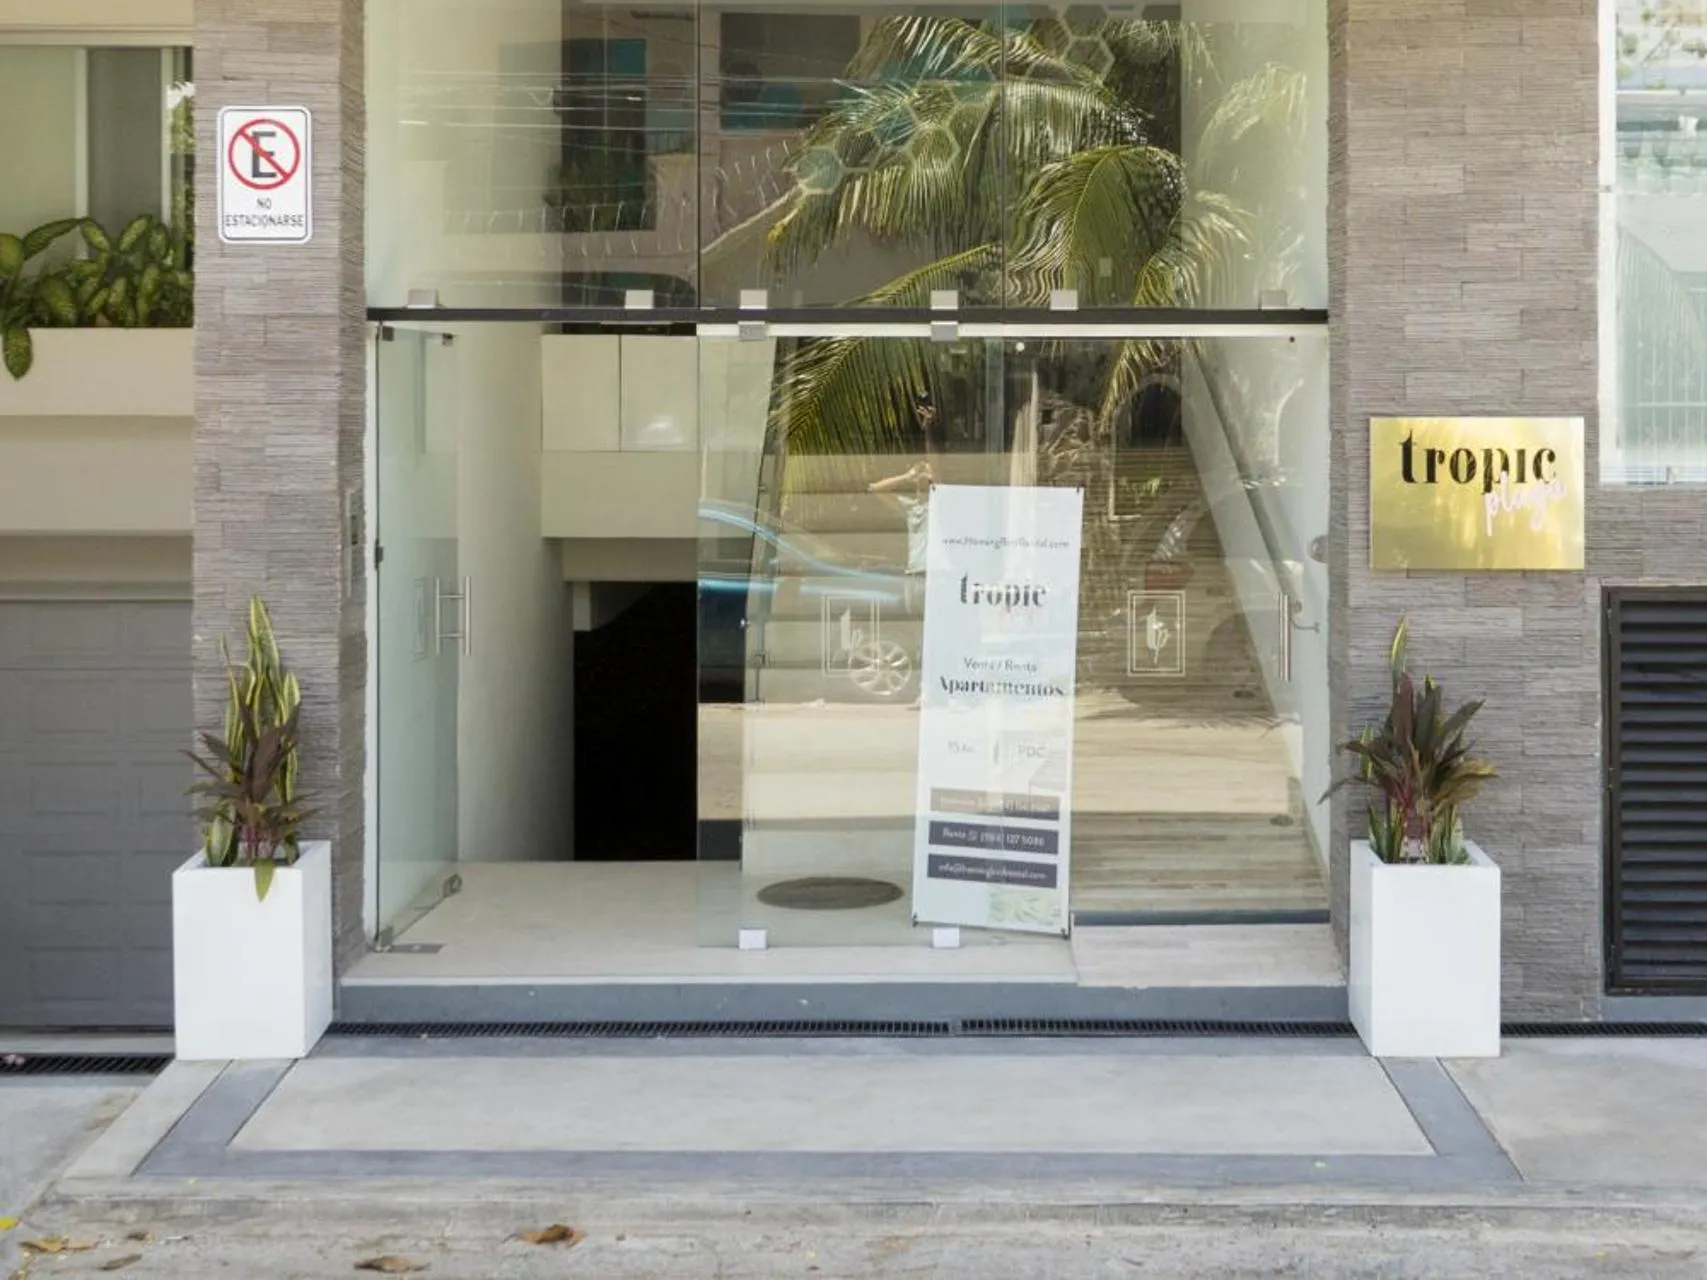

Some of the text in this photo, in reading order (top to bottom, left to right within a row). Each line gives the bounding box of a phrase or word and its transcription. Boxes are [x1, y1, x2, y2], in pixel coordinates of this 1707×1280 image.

[256, 198, 272, 210] NO
[225, 215, 304, 228] ESTACIONARSE
[1399, 428, 1556, 495] tropic
[959, 571, 1047, 613] tropic
